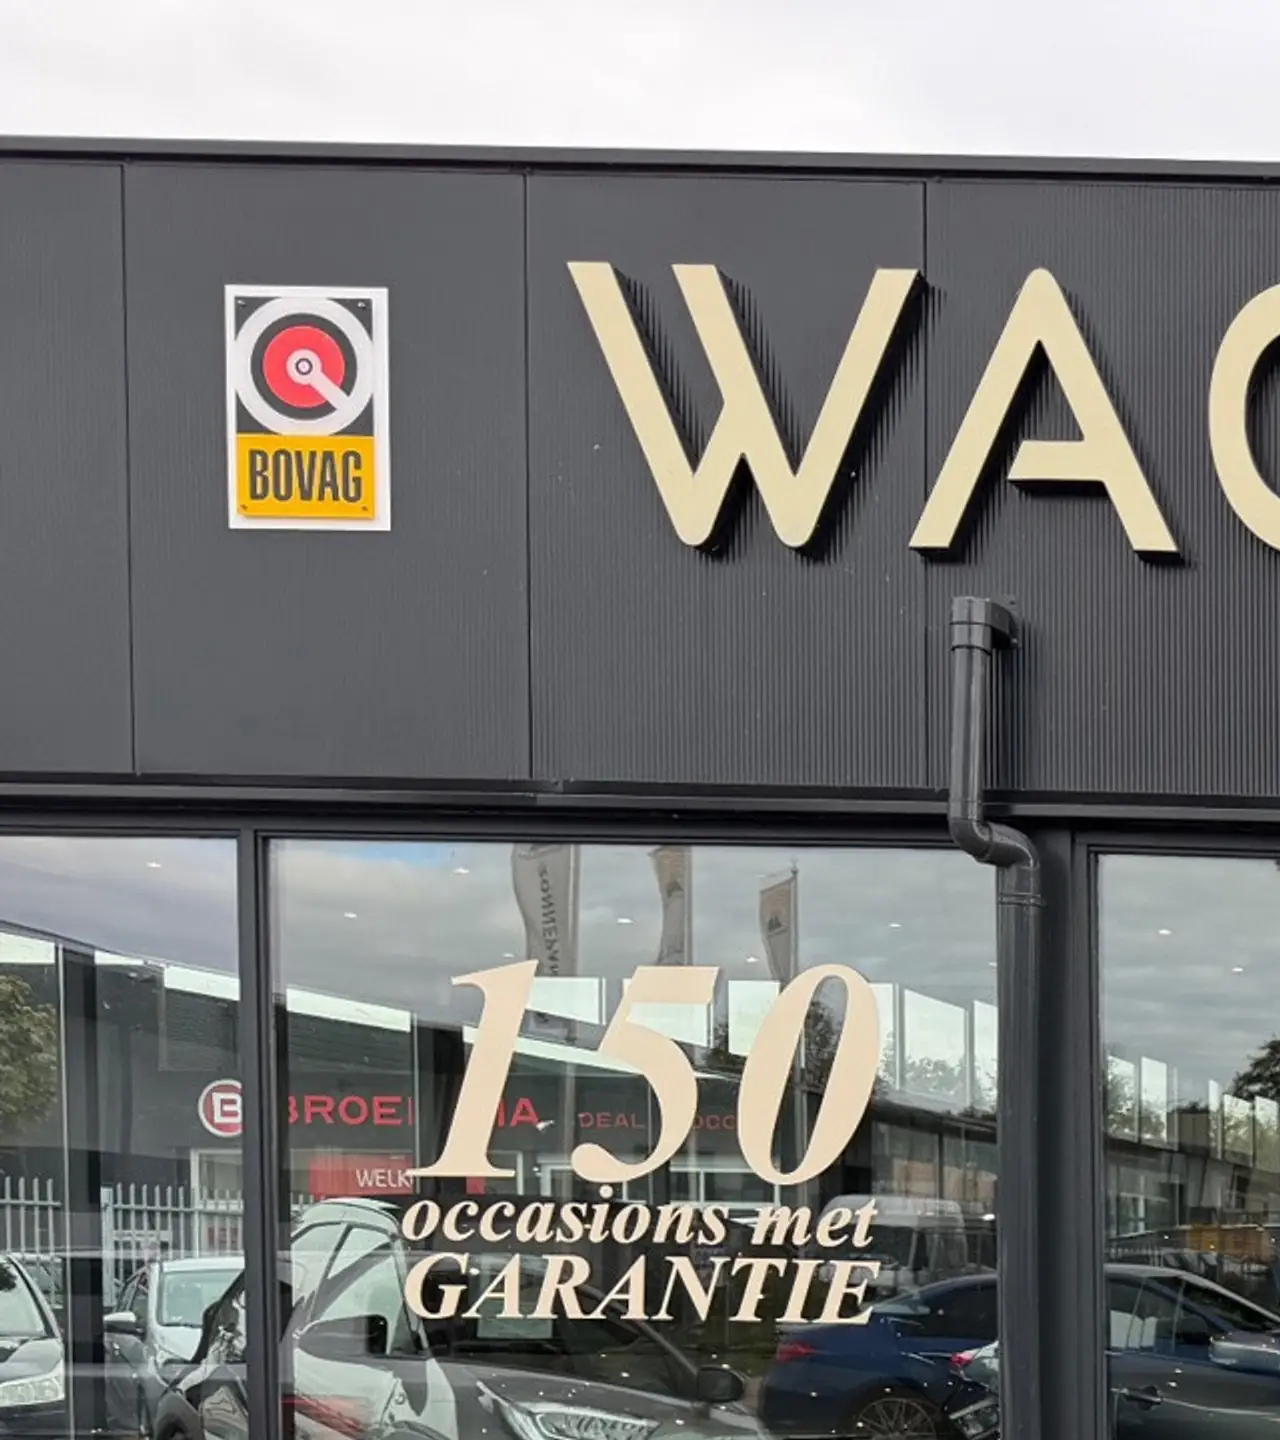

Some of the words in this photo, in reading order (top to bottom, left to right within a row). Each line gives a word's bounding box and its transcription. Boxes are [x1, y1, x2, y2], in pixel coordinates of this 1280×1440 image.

[249, 448, 362, 503] BOVAG
[407, 959, 879, 1185] 150
[401, 1185, 729, 1244] occasions
[751, 1198, 878, 1249] met
[404, 1252, 882, 1326] GARANTIE
